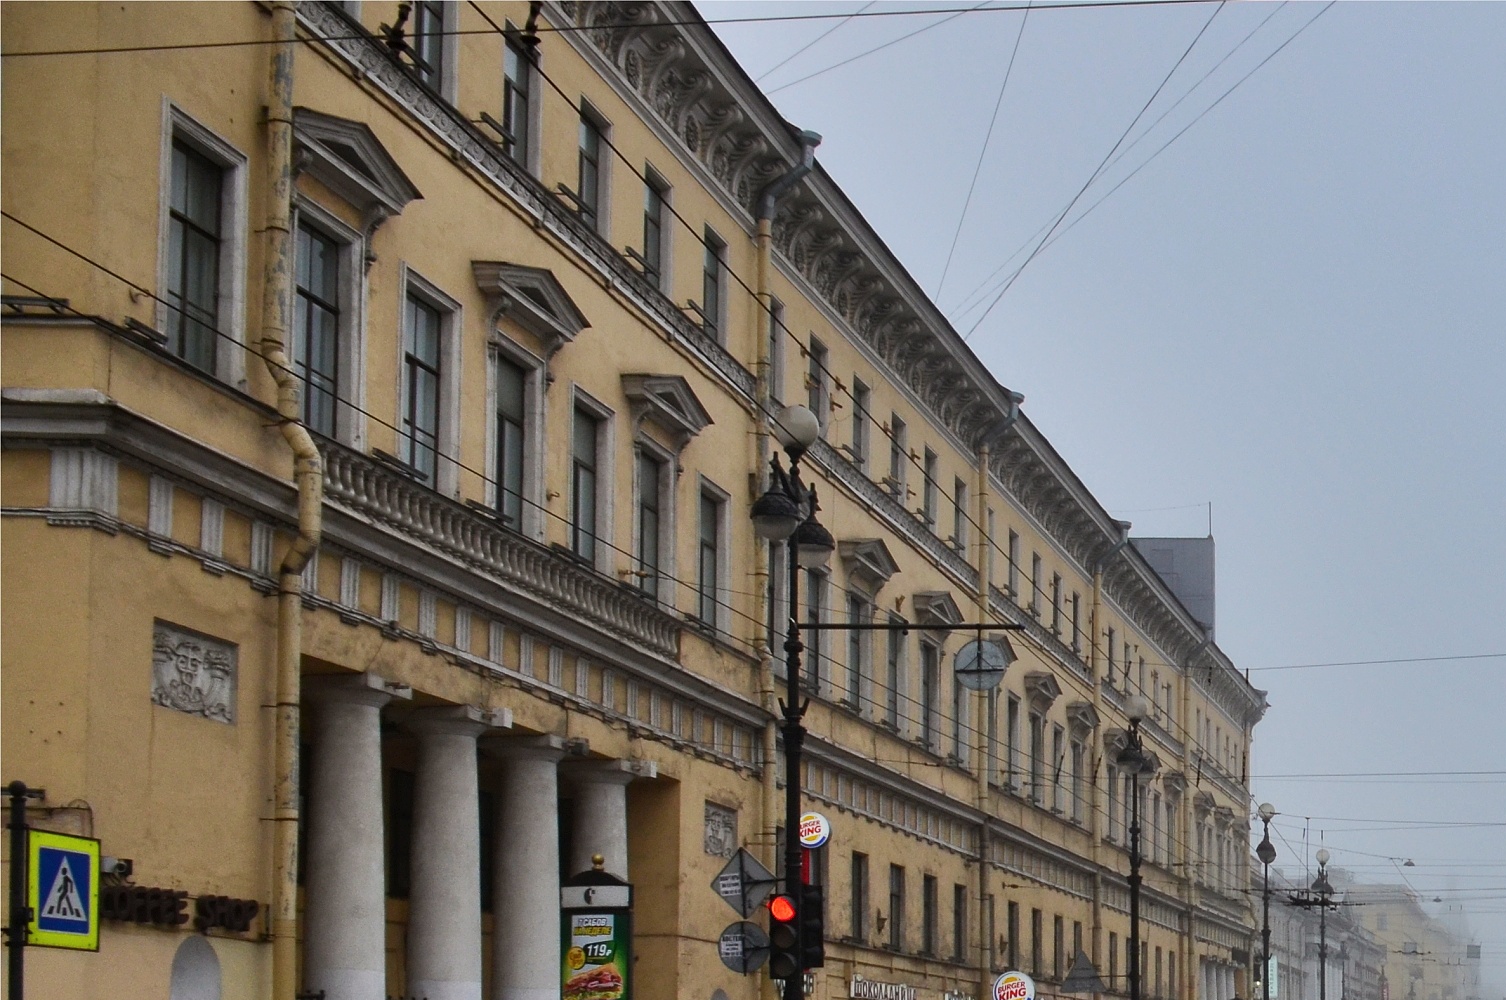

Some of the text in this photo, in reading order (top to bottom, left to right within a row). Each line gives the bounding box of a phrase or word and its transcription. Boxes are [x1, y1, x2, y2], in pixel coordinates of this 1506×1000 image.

[799, 825, 821, 838] KING
[194, 894, 259, 932] SHOP
[998, 981, 1026, 993] BURGER
